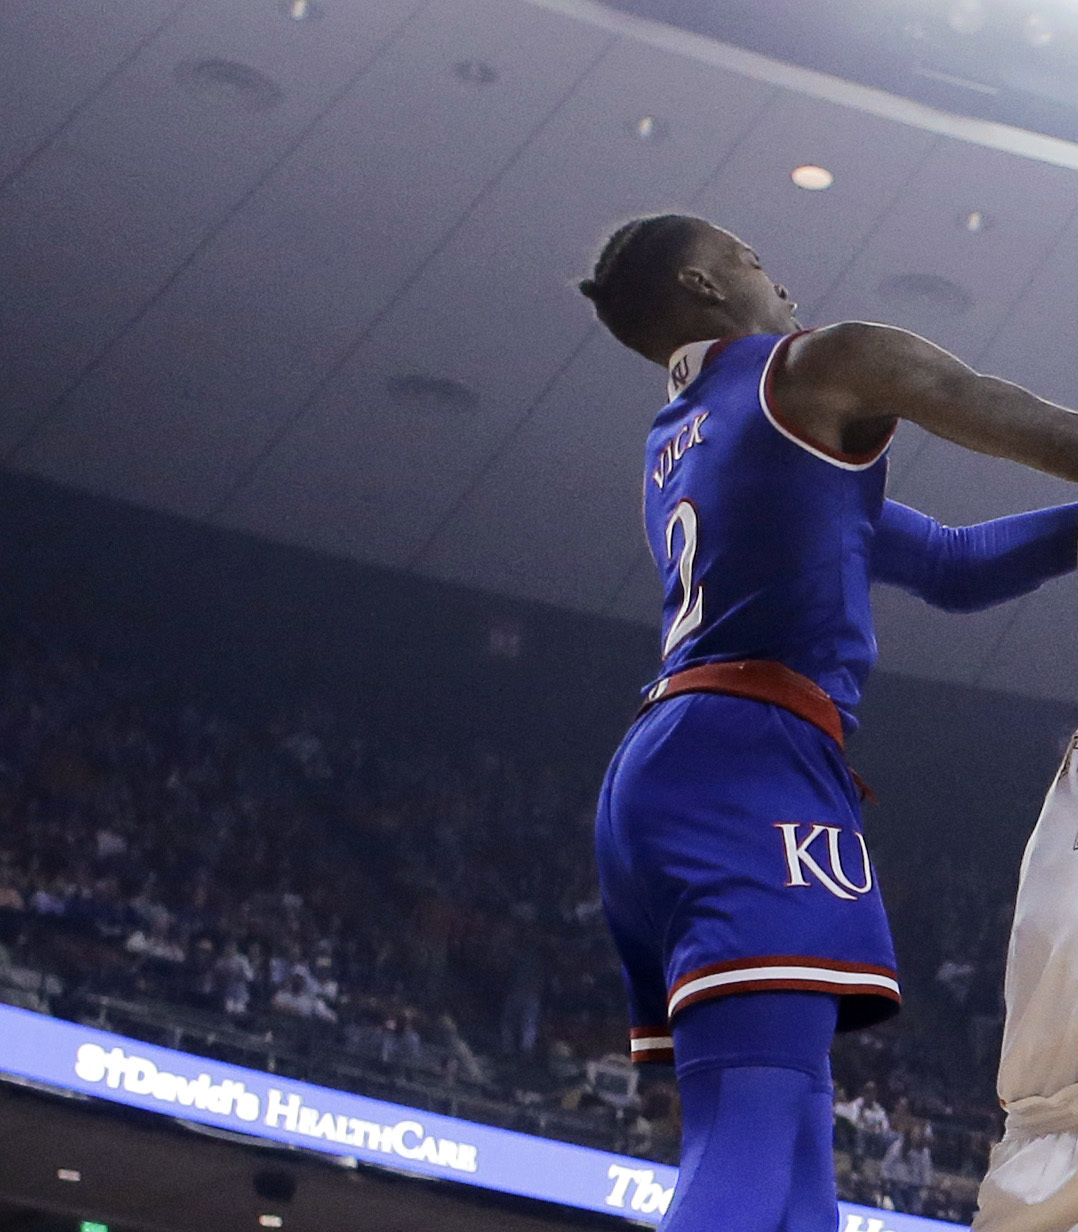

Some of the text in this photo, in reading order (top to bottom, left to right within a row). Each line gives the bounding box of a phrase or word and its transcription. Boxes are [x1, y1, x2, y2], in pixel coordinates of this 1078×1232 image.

[653, 410, 711, 489] VICK
[663, 499, 702, 661] 2
[773, 823, 873, 900] KU
